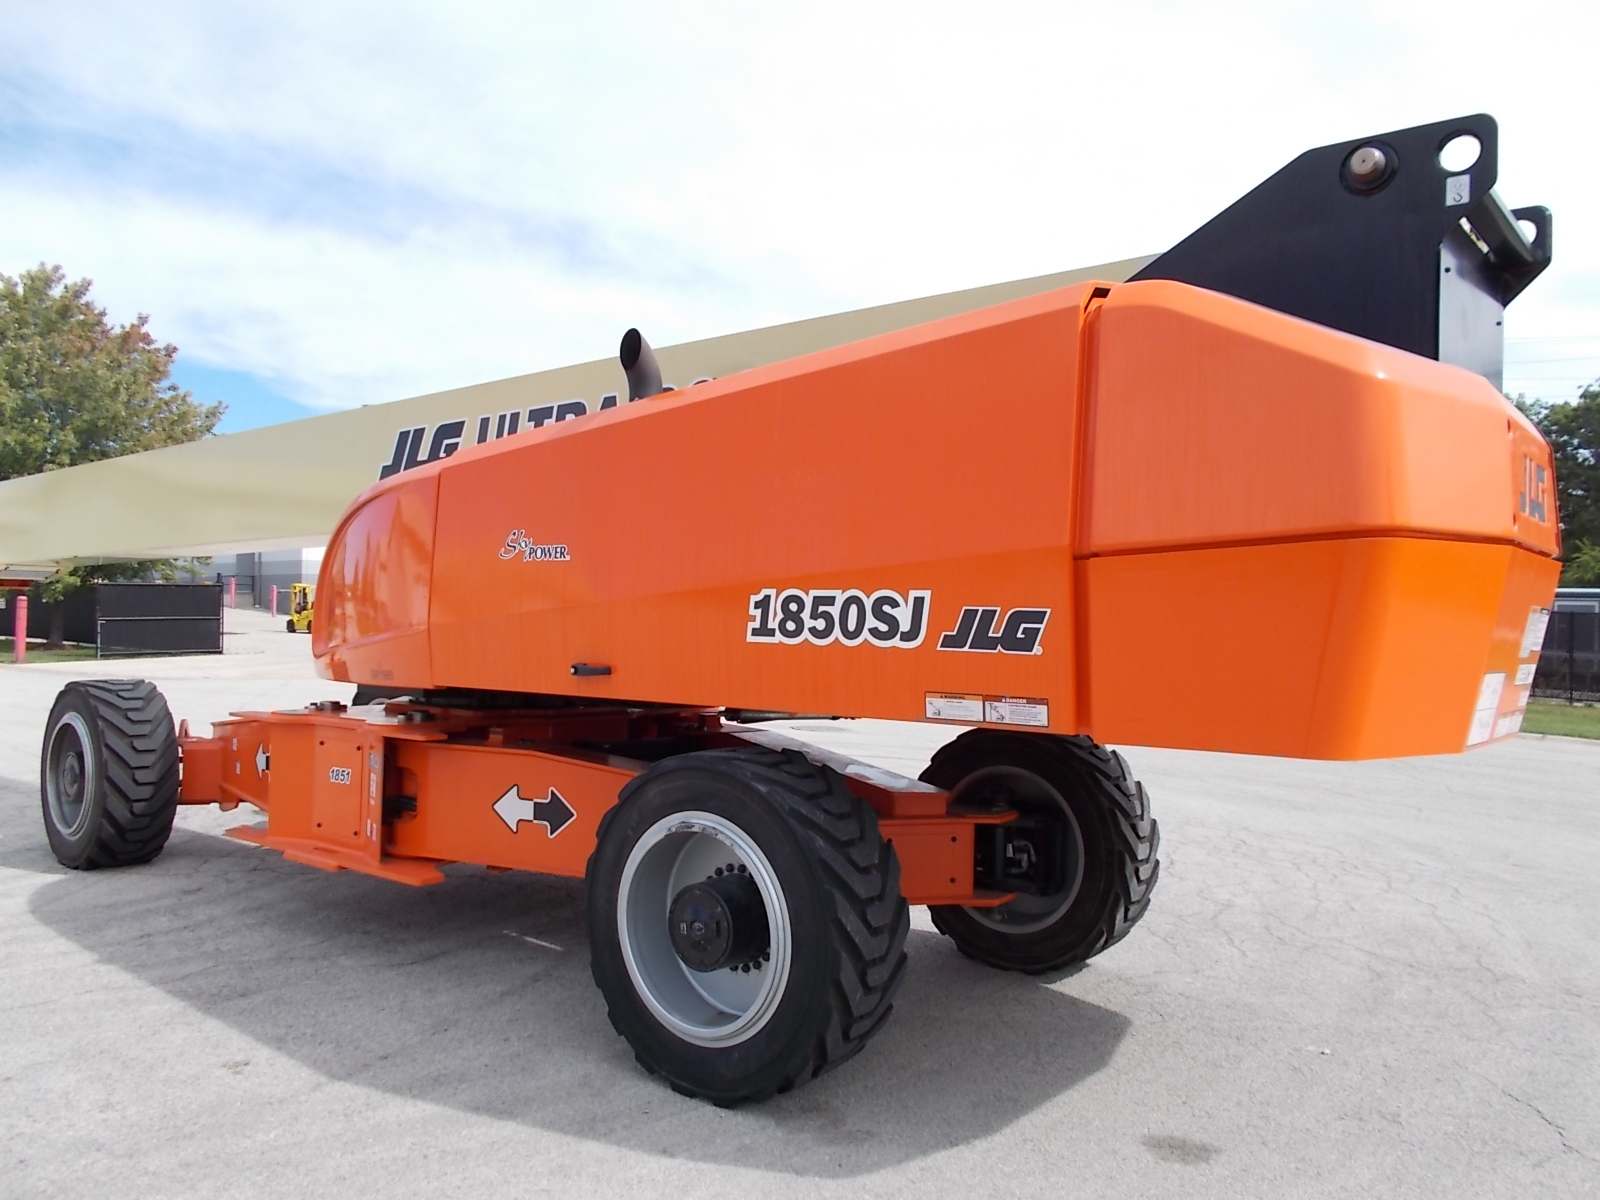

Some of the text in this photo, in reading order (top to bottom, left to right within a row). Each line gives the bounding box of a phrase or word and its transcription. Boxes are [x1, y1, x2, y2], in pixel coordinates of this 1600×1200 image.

[378, 418, 466, 481] JLG
[499, 530, 532, 561] Sky
[527, 545, 569, 560] POWER
[747, 590, 1050, 654] 1850SJ JLG
[329, 767, 351, 784] 1851
